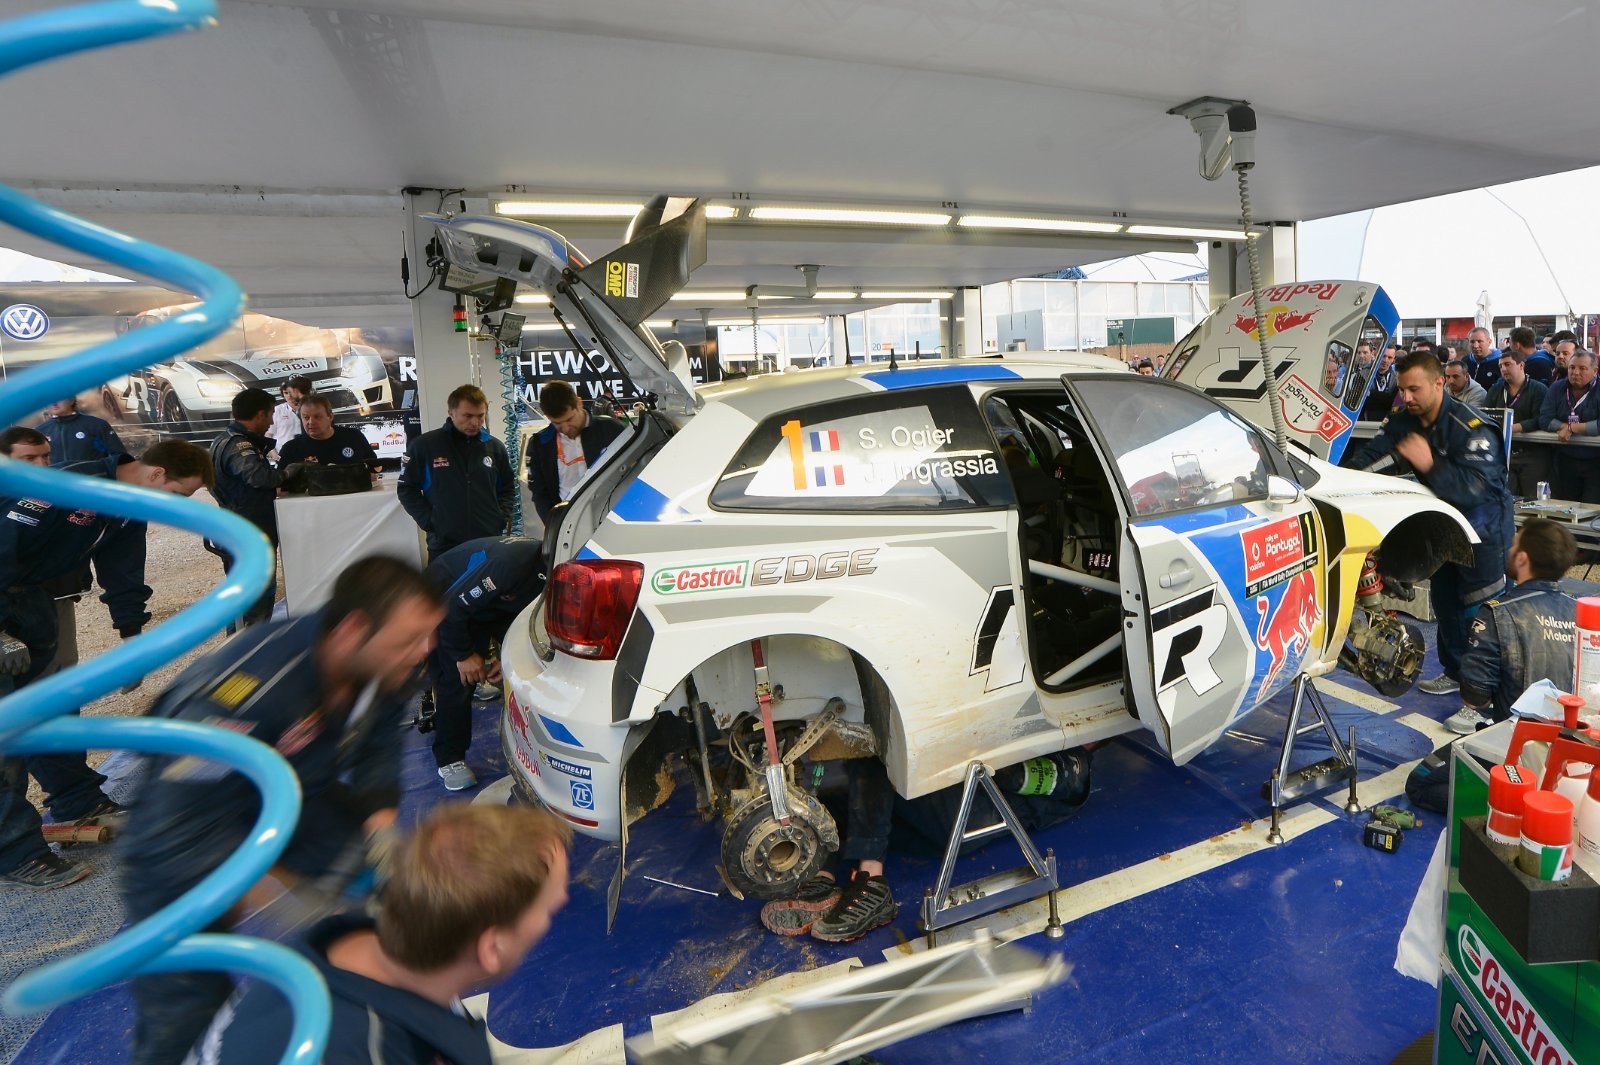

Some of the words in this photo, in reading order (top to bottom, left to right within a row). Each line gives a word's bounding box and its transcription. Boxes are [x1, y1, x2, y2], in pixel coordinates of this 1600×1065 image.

[609, 261, 622, 297] OMP
[780, 419, 808, 491] 1
[857, 427, 883, 450] S.
[890, 424, 955, 451] Ogier
[892, 453, 999, 486] Ingrassia
[676, 564, 743, 591] Castrol
[750, 547, 881, 587] EDGE
[551, 759, 591, 777] MICHELIN
[575, 788, 589, 801] ZF
